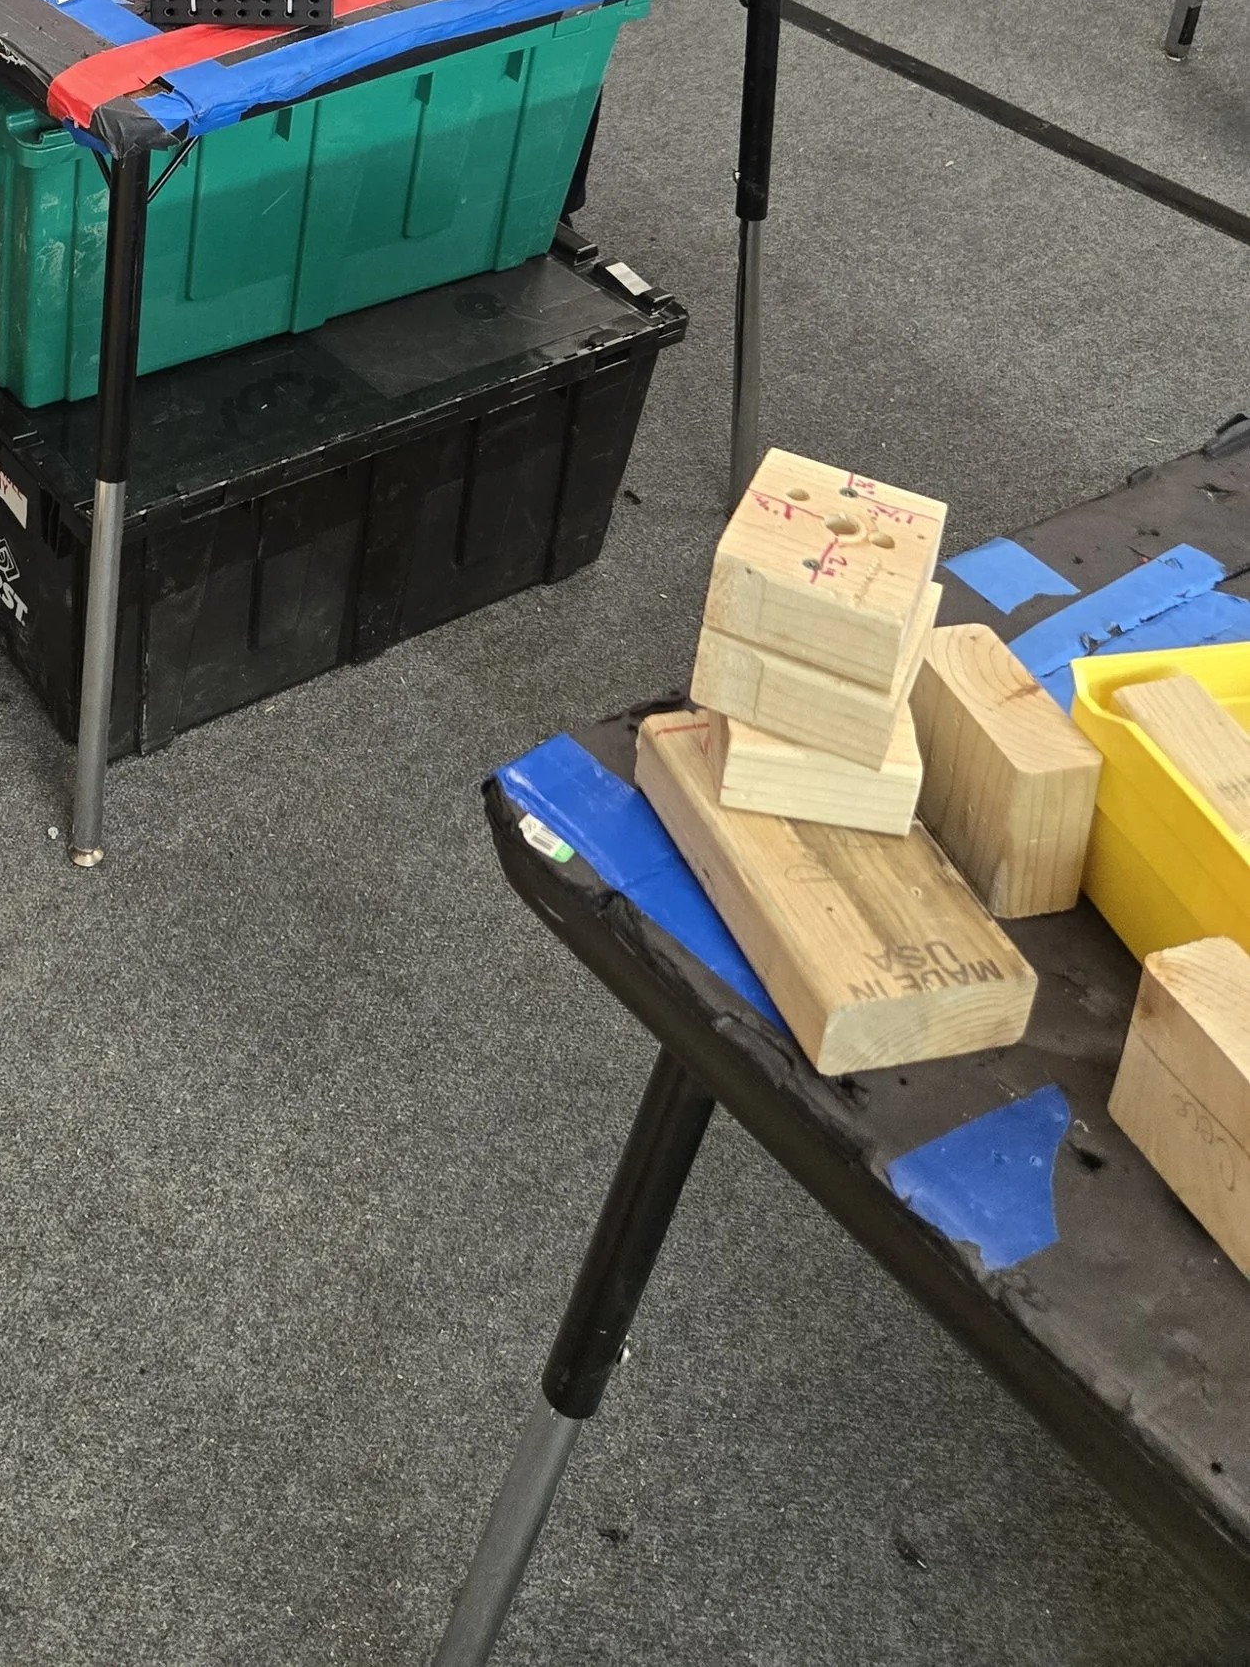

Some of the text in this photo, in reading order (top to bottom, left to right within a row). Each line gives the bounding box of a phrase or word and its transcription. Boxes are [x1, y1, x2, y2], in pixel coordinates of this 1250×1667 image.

[862, 940, 962, 974] USA
[847, 958, 1005, 1000] MADE IN
